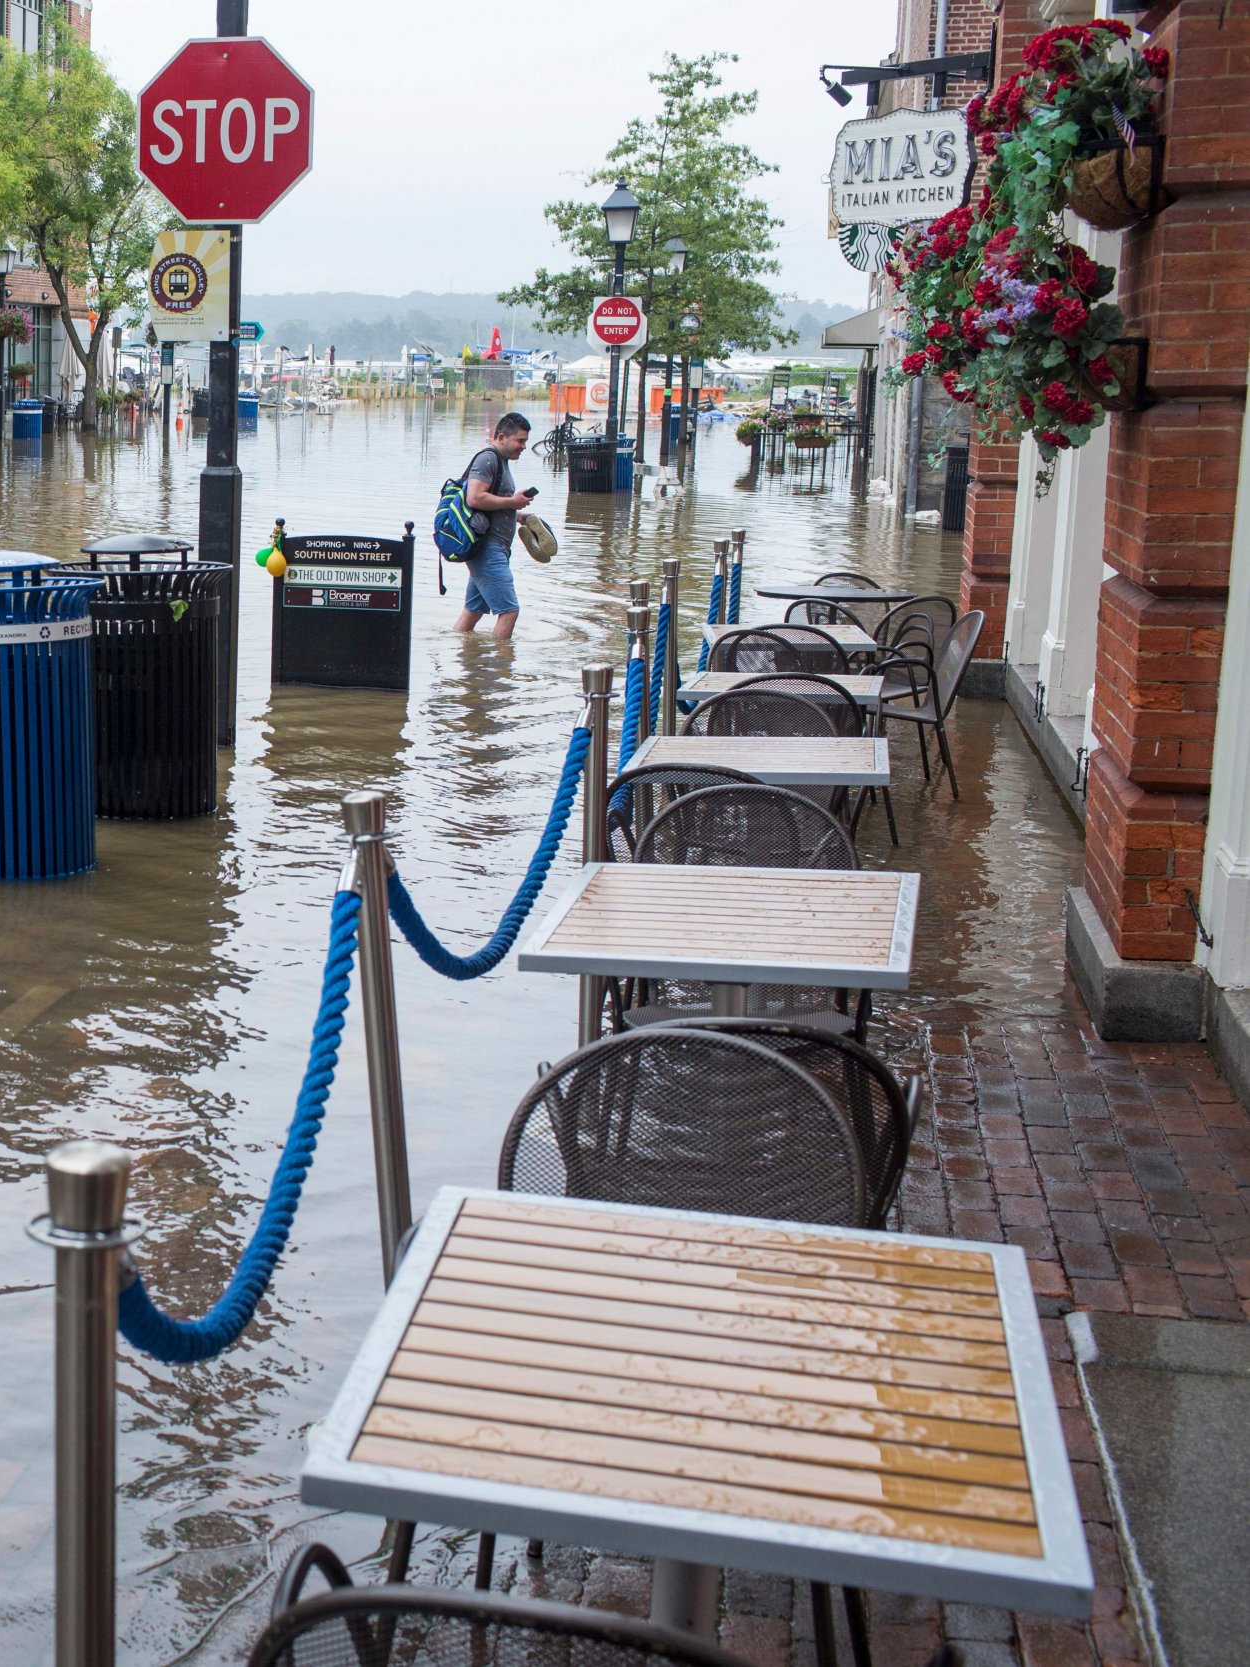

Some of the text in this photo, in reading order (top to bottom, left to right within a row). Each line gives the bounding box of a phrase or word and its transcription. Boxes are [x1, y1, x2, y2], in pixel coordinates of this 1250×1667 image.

[149, 97, 300, 165] STOP
[843, 130, 957, 185] MIA'S
[842, 186, 954, 207] ITALIAN KITCHEN
[158, 257, 187, 273] STREET
[188, 259, 204, 294] TROLLEY
[165, 301, 193, 309] FREE
[602, 307, 634, 315] DO NOT
[603, 327, 629, 335] ENTER
[306, 540, 341, 549] SHOPPING
[294, 550, 393, 562] SOUTH UNION STREET
[298, 569, 387, 583] THE OLD TOWN SHOP
[329, 589, 372, 601] Braemar
